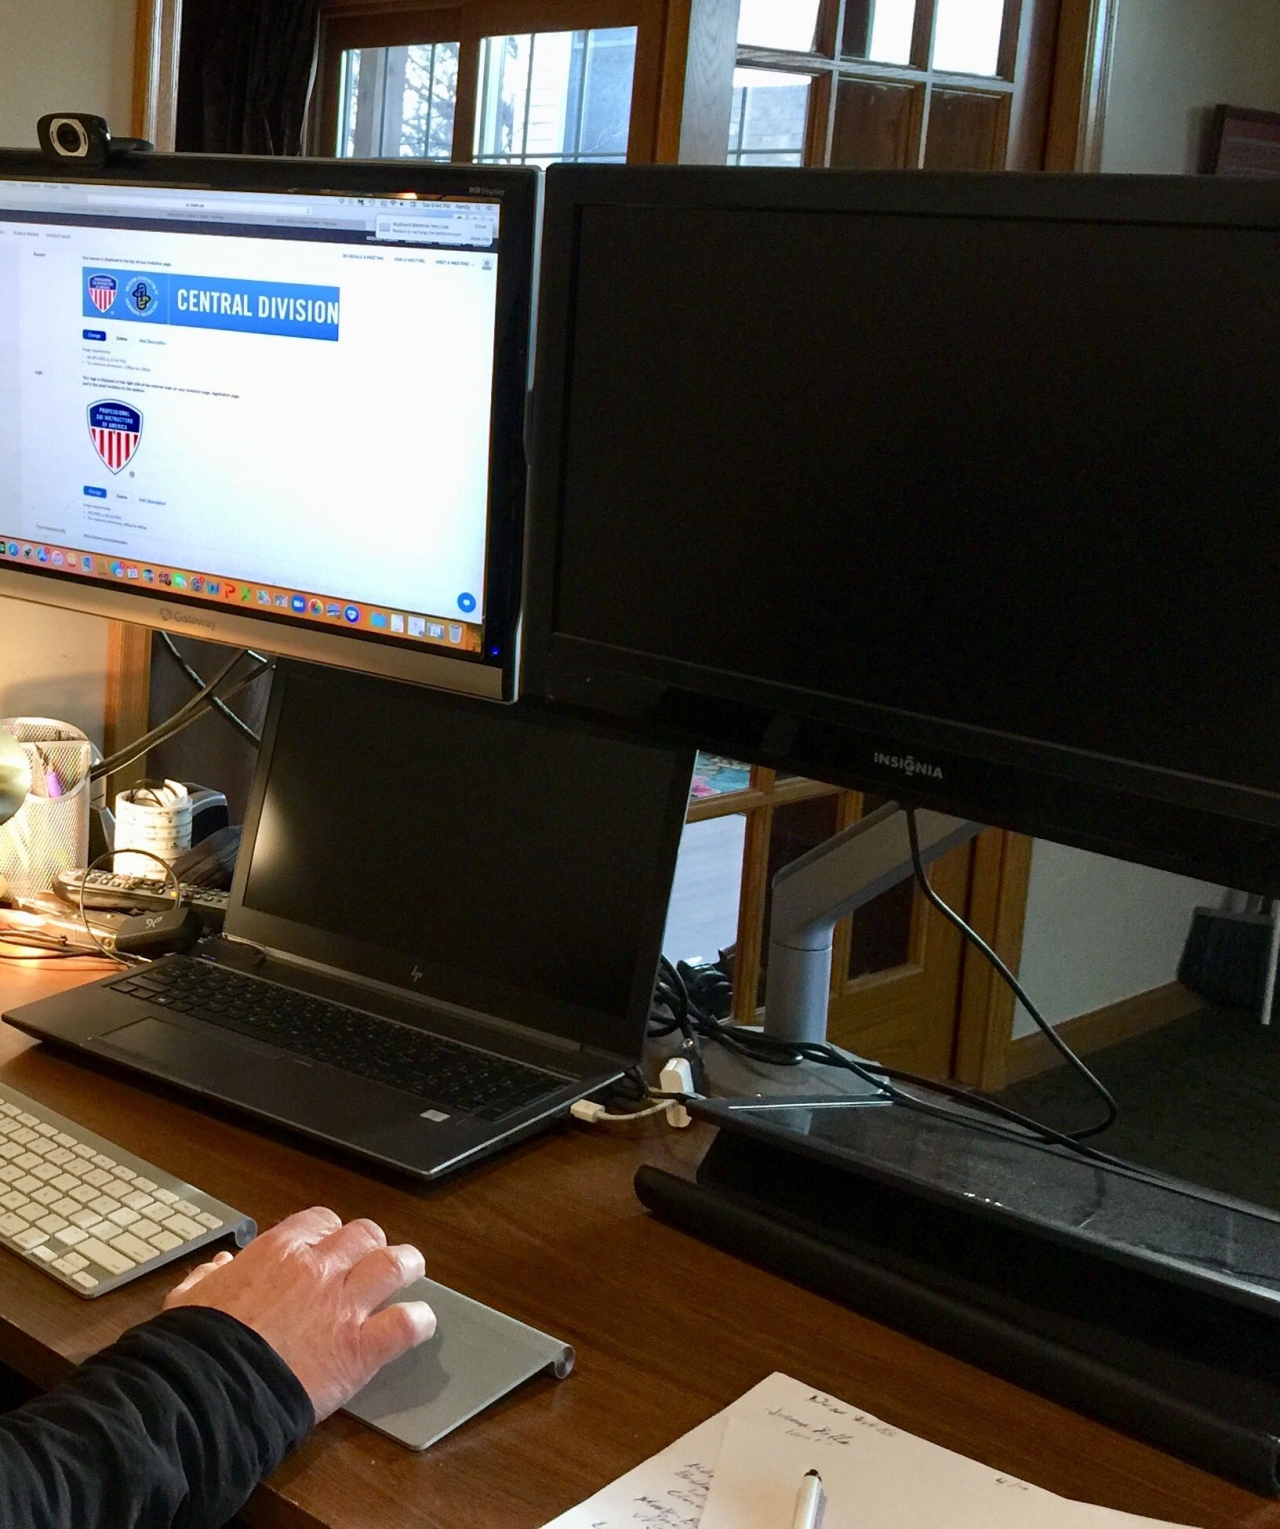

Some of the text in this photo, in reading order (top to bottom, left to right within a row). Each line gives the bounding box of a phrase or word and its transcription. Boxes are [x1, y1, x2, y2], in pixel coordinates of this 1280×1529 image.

[178, 289, 252, 317] CENTRAL
[258, 295, 338, 324] DIVISION
[99, 407, 130, 417] PROFESSIONAL
[105, 415, 133, 424] INSTRUCTORS
[174, 611, 216, 630] Gateway
[874, 752, 943, 779] INSIGNIA
